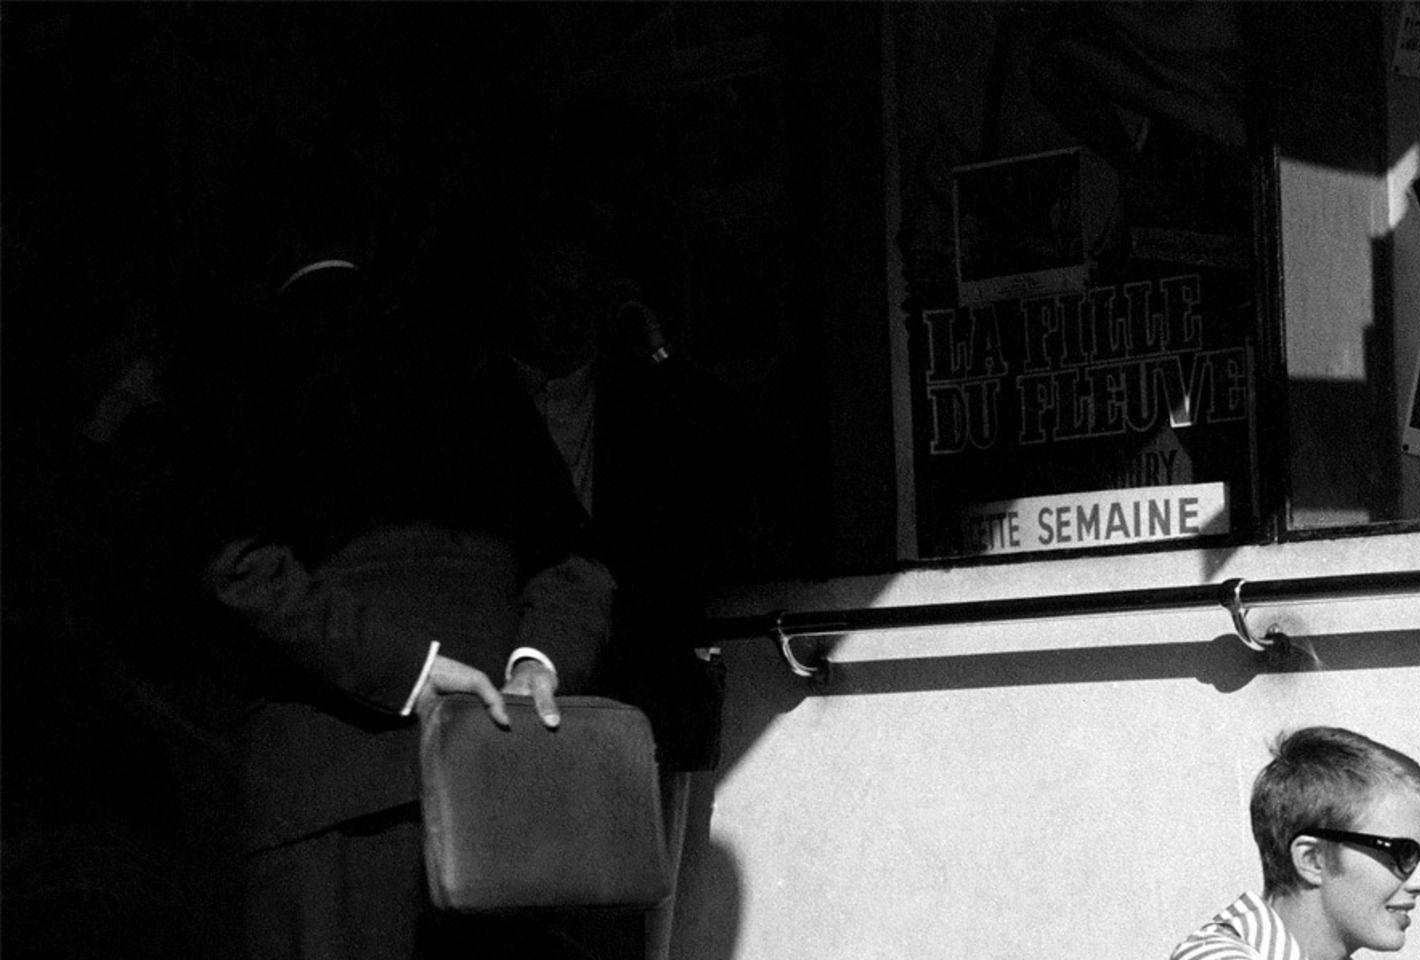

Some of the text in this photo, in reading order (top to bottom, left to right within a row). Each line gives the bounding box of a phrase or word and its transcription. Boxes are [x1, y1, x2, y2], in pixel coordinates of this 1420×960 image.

[923, 275, 1201, 382] LA FILLE
[926, 347, 1249, 455] DU FLEUVE
[1038, 497, 1201, 546] SEMAINE
